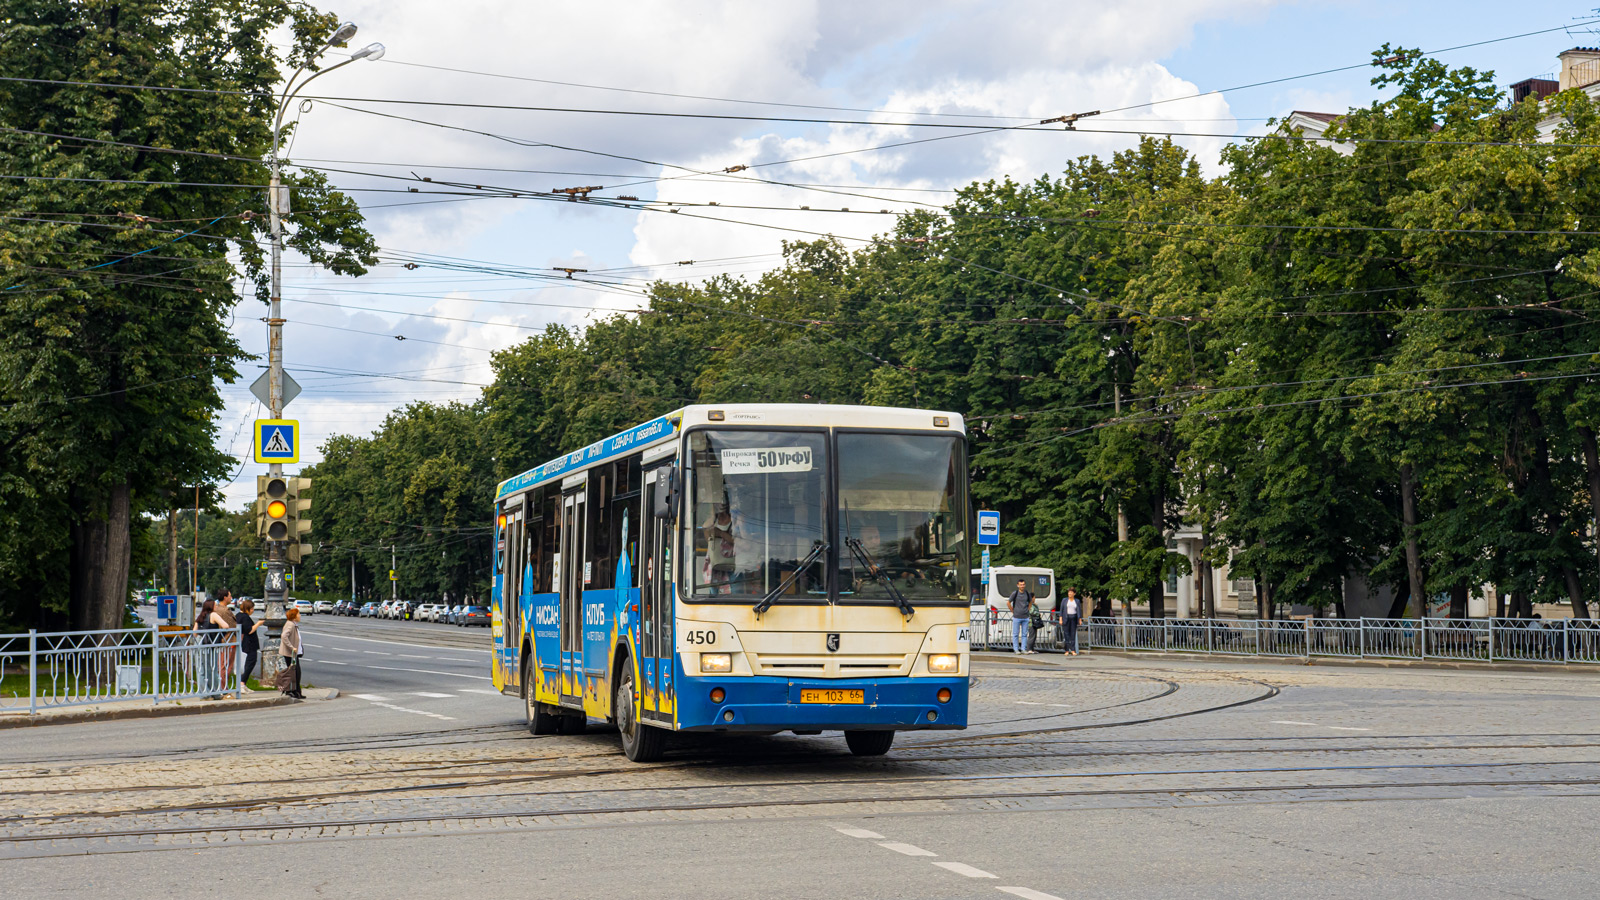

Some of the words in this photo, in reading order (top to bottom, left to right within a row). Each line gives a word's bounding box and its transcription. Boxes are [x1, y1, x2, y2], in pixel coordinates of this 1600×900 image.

[757, 451, 777, 468] 50
[778, 450, 811, 465] УрФУ
[586, 603, 605, 625] КЛУБ
[686, 630, 716, 645] 450
[806, 693, 819, 701] ЕН
[824, 691, 844, 702] 103
[849, 690, 860, 699] 66
